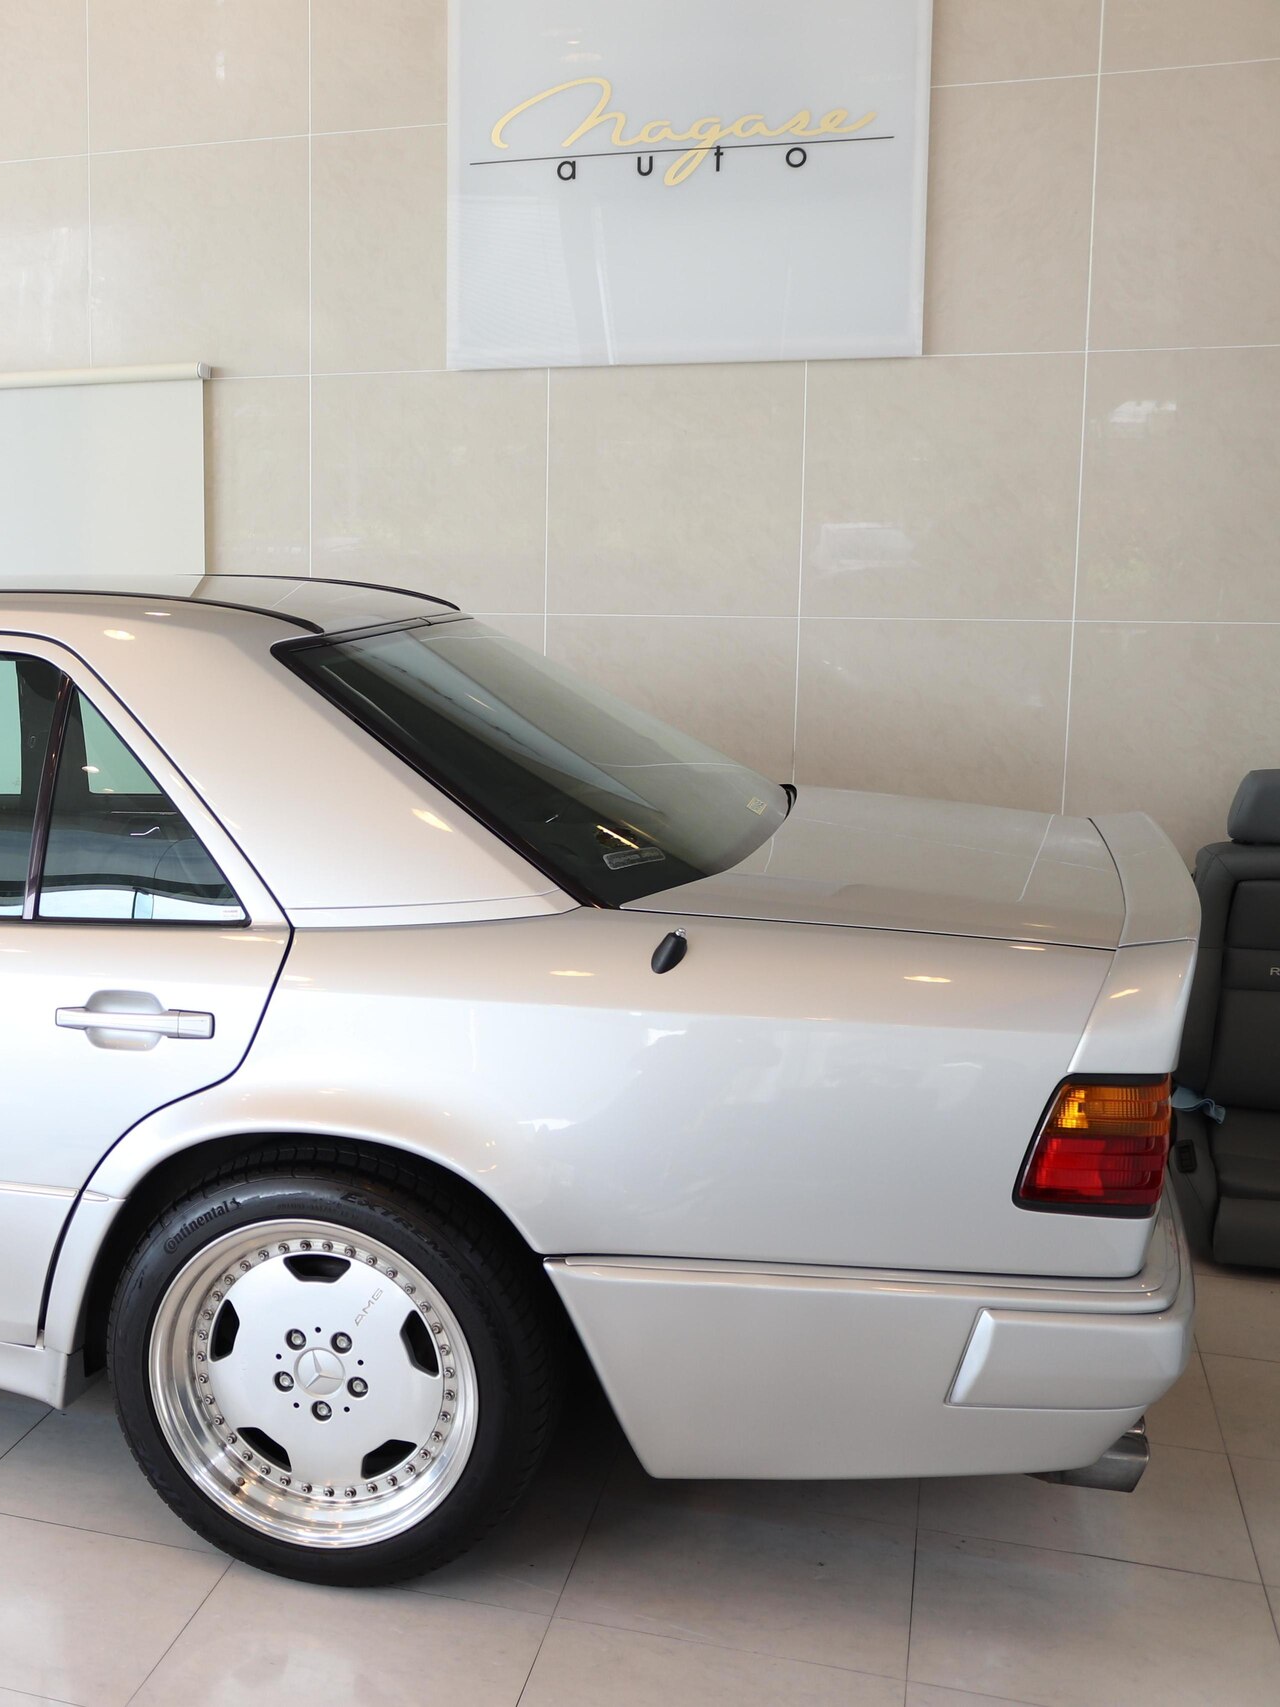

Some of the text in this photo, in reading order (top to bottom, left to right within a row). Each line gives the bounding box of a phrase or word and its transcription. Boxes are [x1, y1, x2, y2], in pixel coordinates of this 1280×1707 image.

[490, 76, 878, 187] Nagase
[556, 145, 808, 182] auto
[163, 1200, 230, 1254] Continental
[354, 1287, 383, 1327] AMG
